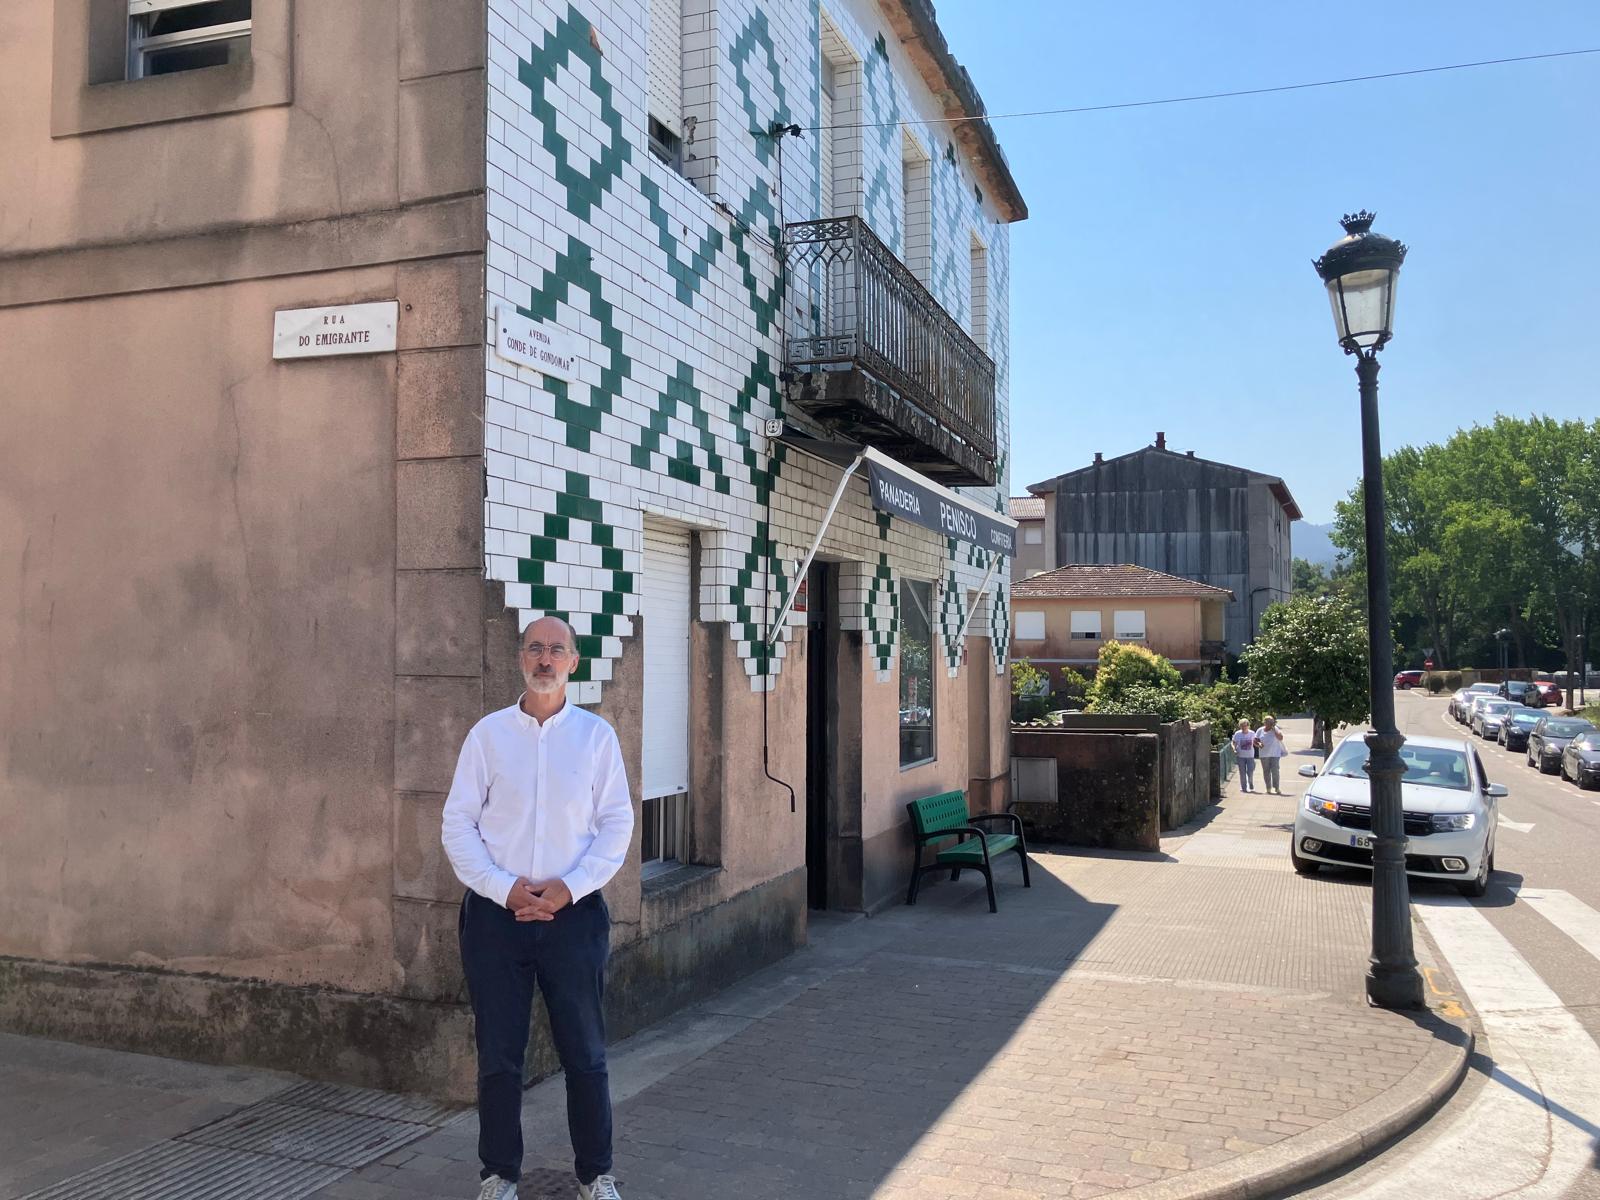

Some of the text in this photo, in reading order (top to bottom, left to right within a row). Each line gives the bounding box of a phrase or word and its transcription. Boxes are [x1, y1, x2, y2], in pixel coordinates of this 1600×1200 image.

[323, 315, 345, 325] RUA
[299, 330, 370, 347] DO EMIGRANTE
[529, 329, 551, 345] AVENIDA
[507, 336, 570, 371] CONDE DE GONDOMAR
[879, 480, 921, 515] PANADERÍA
[939, 502, 977, 540] PENISCO
[1357, 837, 1370, 847] 68
